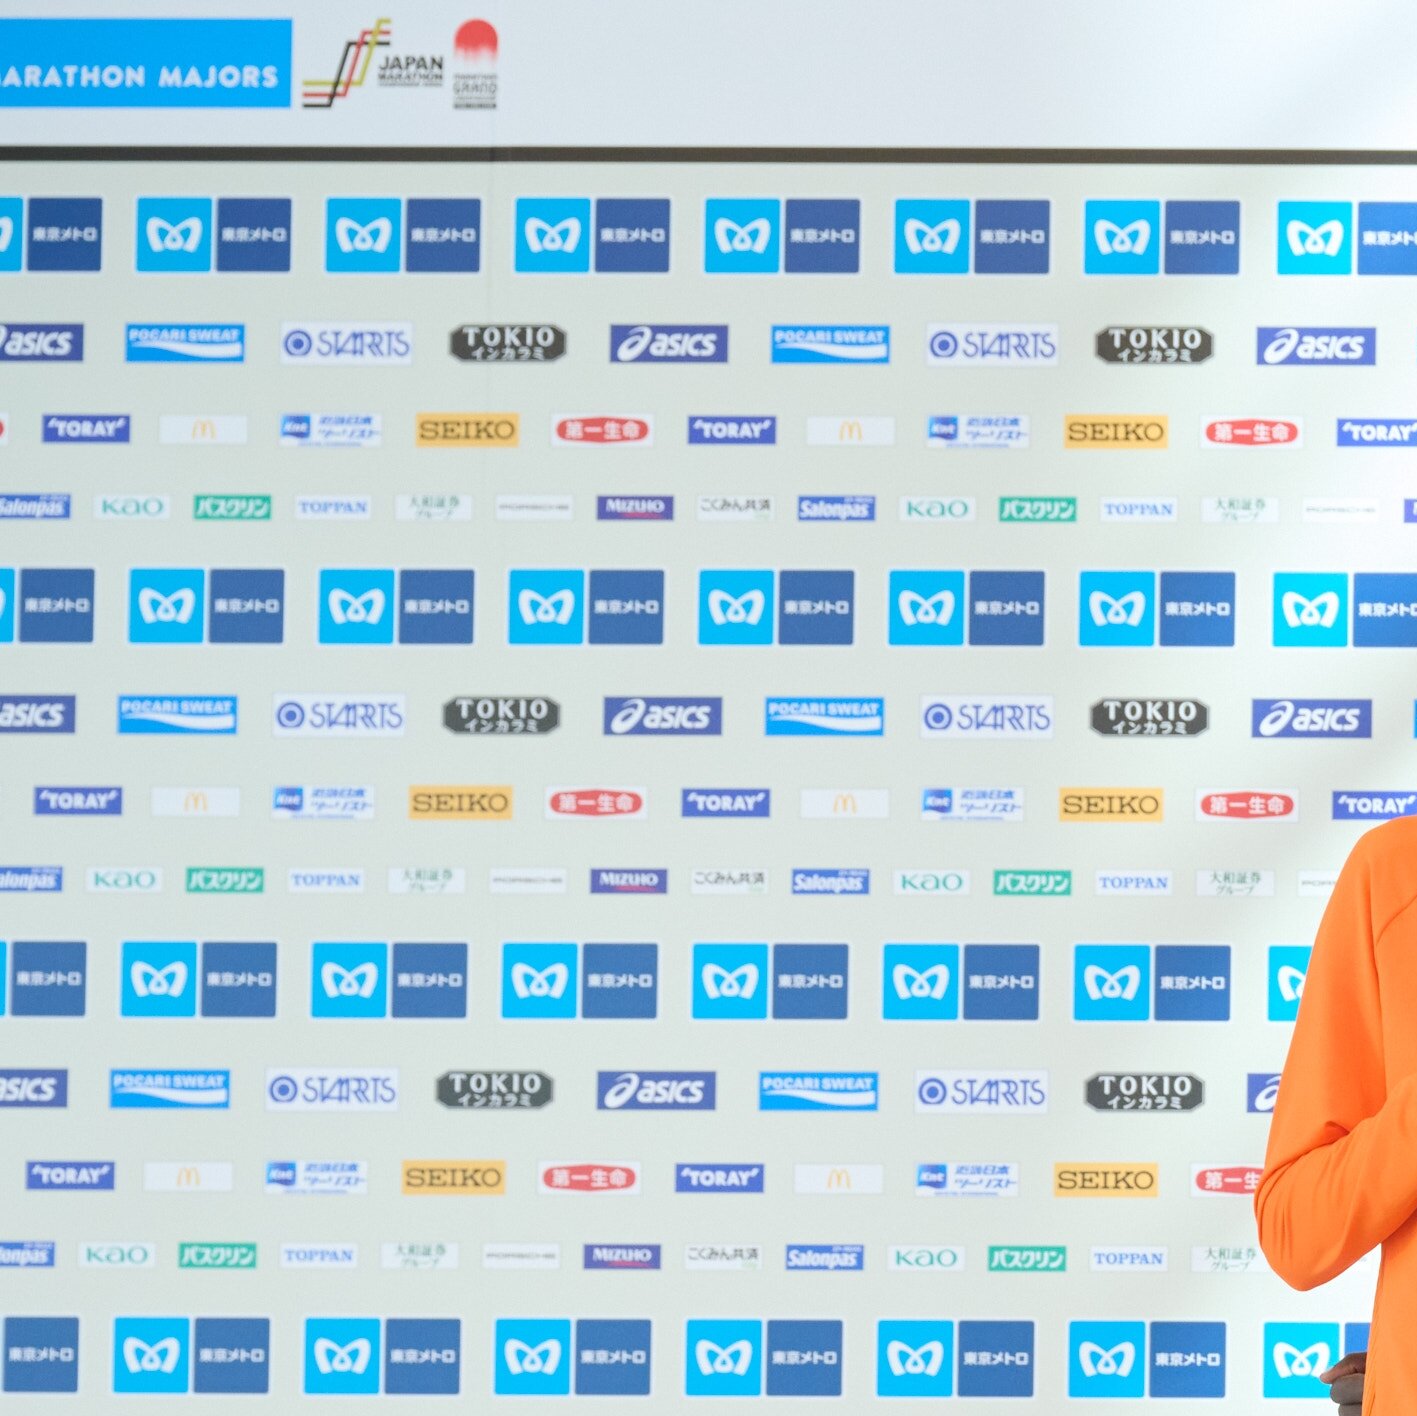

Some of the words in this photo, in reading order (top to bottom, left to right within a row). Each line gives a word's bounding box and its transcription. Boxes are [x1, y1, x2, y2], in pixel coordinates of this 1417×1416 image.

[379, 56, 443, 70] JAPAN
[0, 65, 146, 88] ARATHON
[158, 65, 279, 88] MAJORS
[4, 331, 74, 356] asics
[565, 421, 638, 438] 第一生命
[1099, 876, 1168, 889] TOPPAN
[638, 1081, 704, 1103] asics
